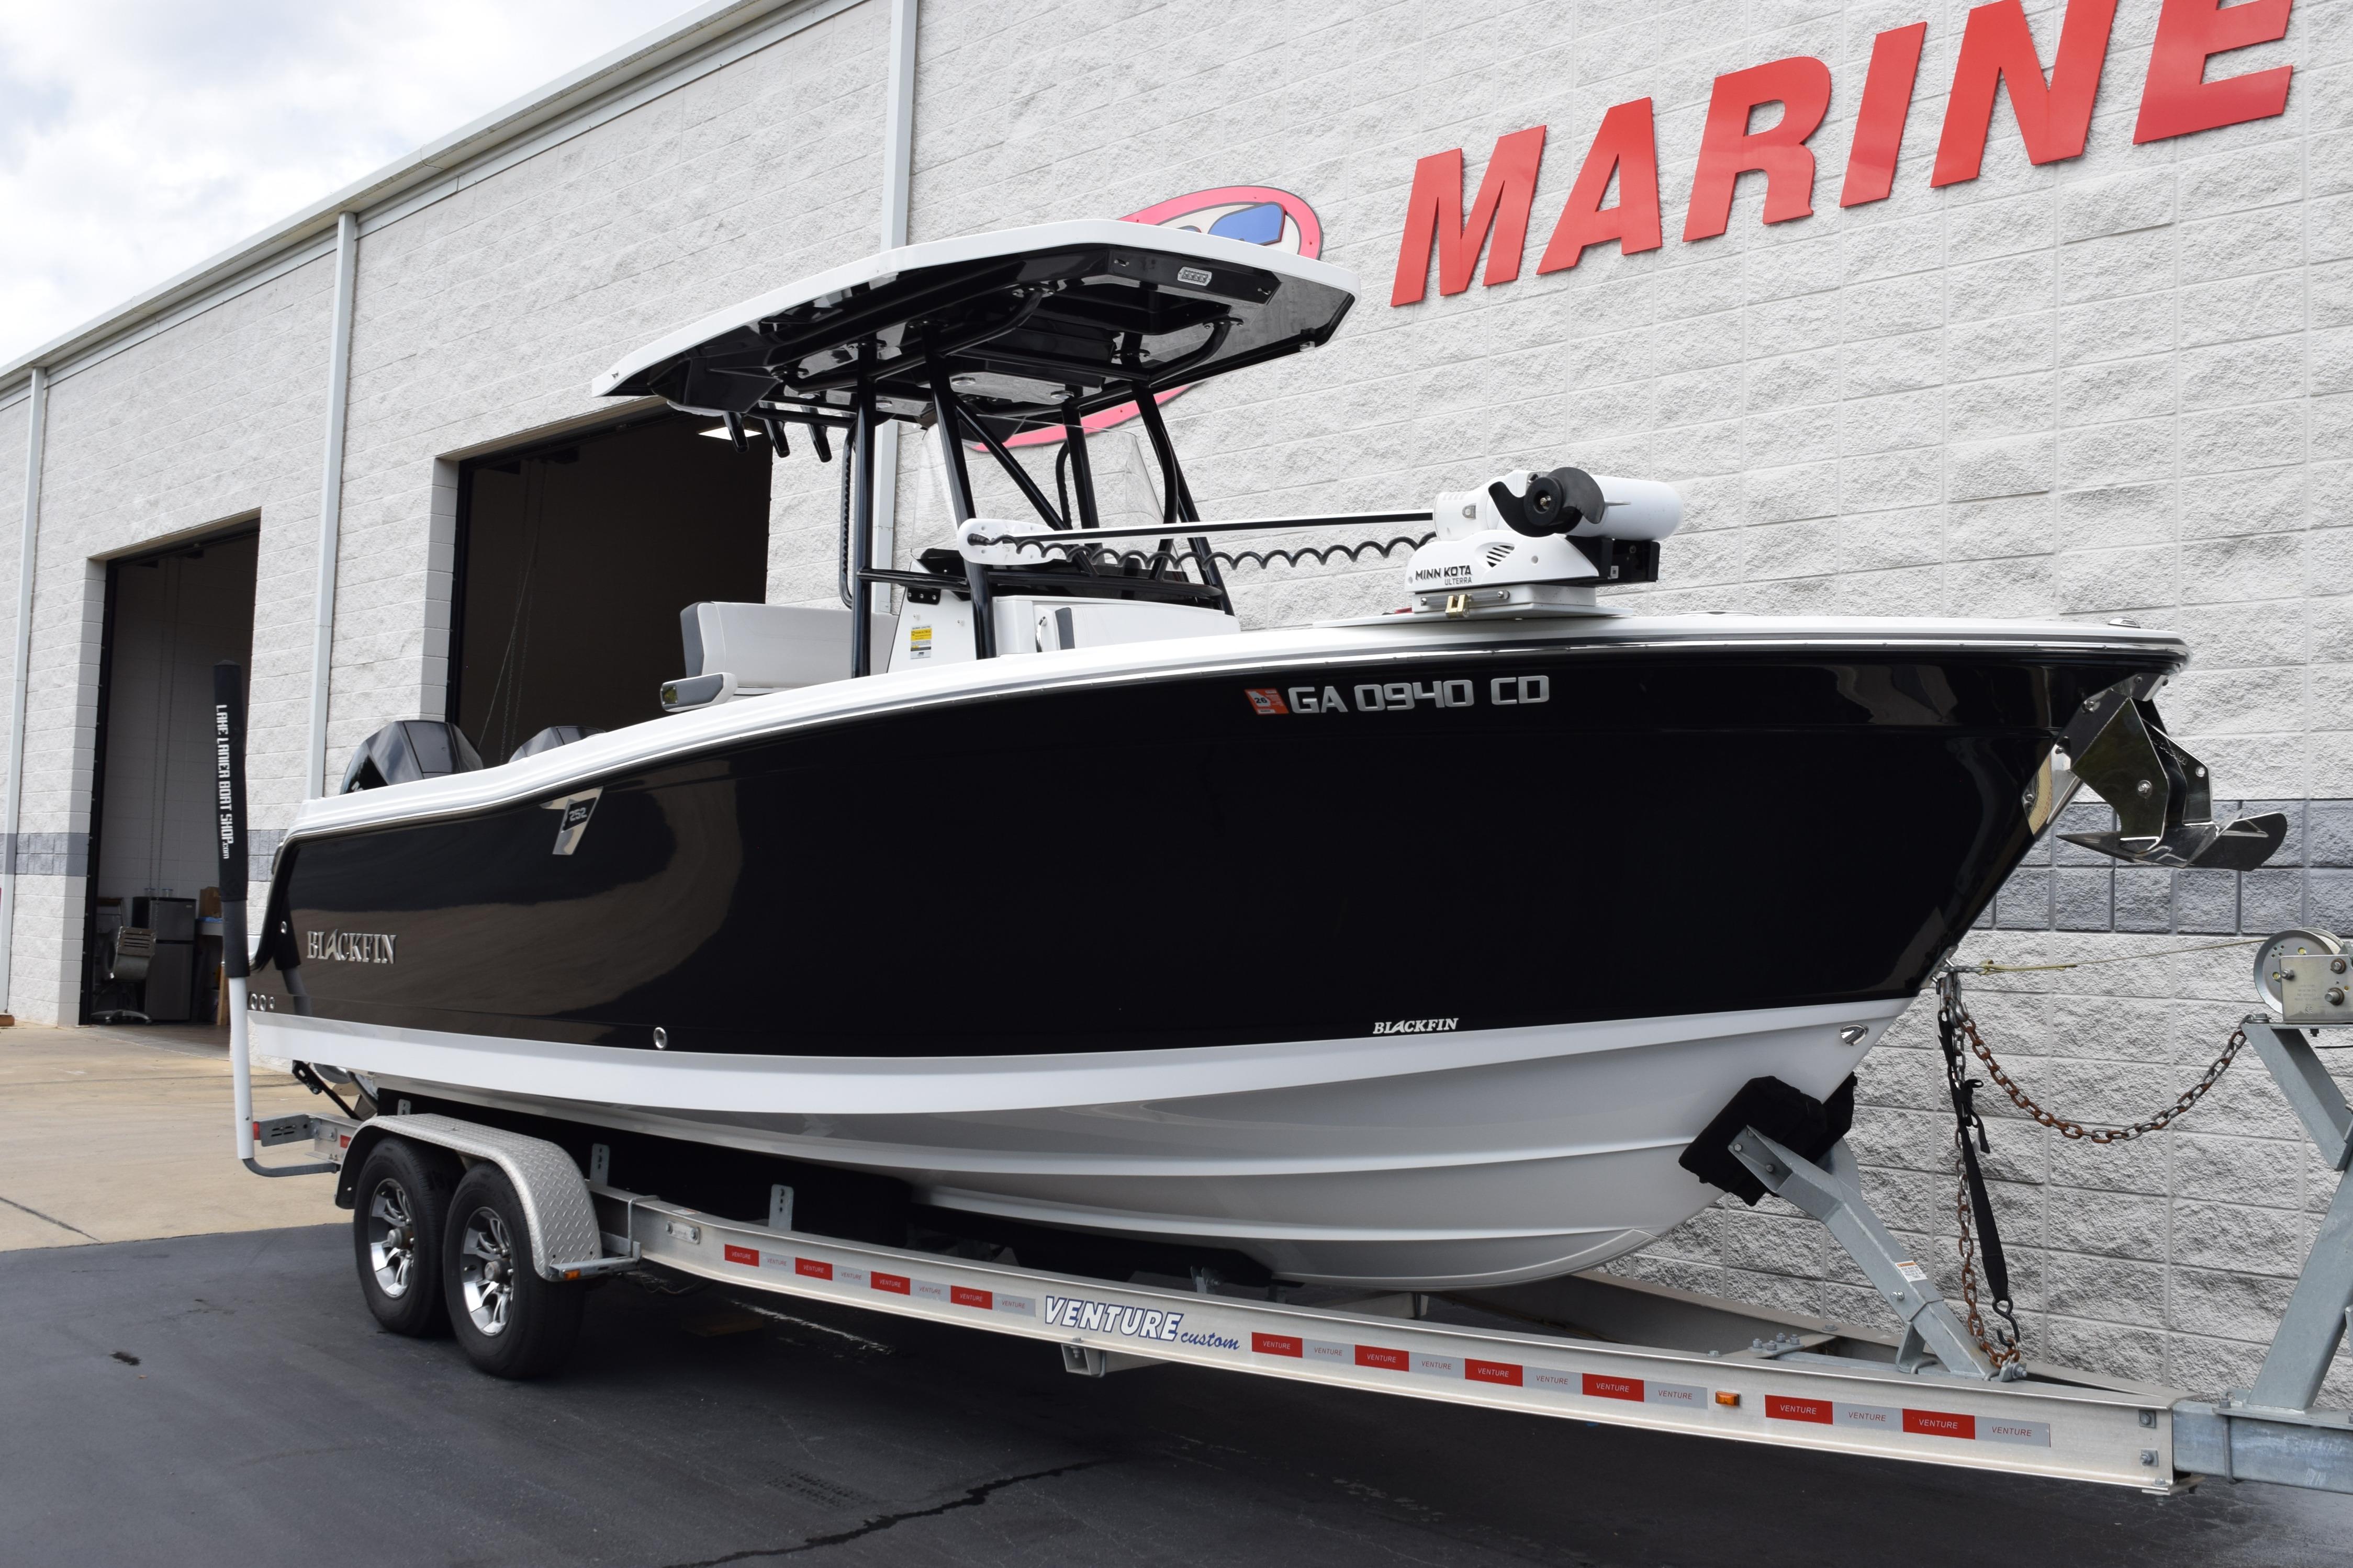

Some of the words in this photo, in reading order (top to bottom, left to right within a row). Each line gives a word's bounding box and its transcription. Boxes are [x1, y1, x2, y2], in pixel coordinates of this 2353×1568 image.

[1391, 0, 2293, 307] MARINE
[1415, 568, 1441, 581] MINN
[1443, 565, 1473, 578] KOTA
[1444, 576, 1473, 585] ULTERRA
[1287, 685, 1348, 714] GA
[1354, 679, 1475, 712] 0940
[216, 704, 229, 735] LAKE
[217, 737, 230, 778] LANIER
[218, 781, 232, 811] BOAT
[569, 807, 588, 822] 252
[307, 929, 397, 964] BLACKFIN
[1372, 1018, 1459, 1034] BLACKFIN
[731, 1251, 752, 1260] VENTURE
[767, 1257, 787, 1267] VENTURE
[803, 1264, 825, 1273] VENTURE
[840, 1271, 862, 1280] VENTURE
[879, 1278, 902, 1288] VENTURE
[918, 1286, 942, 1295] VENTURE
[959, 1293, 983, 1302] VENTURE
[1001, 1300, 1025, 1309] VENTURE
[1045, 1295, 1185, 1342] VENTURE
[1180, 1330, 1241, 1350] custom
[1262, 1339, 1292, 1350] VENTURE
[1313, 1346, 1343, 1357] VENTURE
[1366, 1352, 1397, 1363] VENTURE
[1420, 1360, 1452, 1371] VENTURE
[1477, 1367, 1510, 1379] VENTURE
[1535, 1374, 1569, 1386] VENTURE
[1595, 1382, 1630, 1393] VENTURE
[1657, 1390, 1693, 1401] VENTURE
[1779, 1403, 1818, 1416] VENTURE
[1847, 1411, 1887, 1423] VENTURE
[1918, 1417, 1958, 1430] VENTURE
[1991, 1425, 2033, 1438] VENTURE
